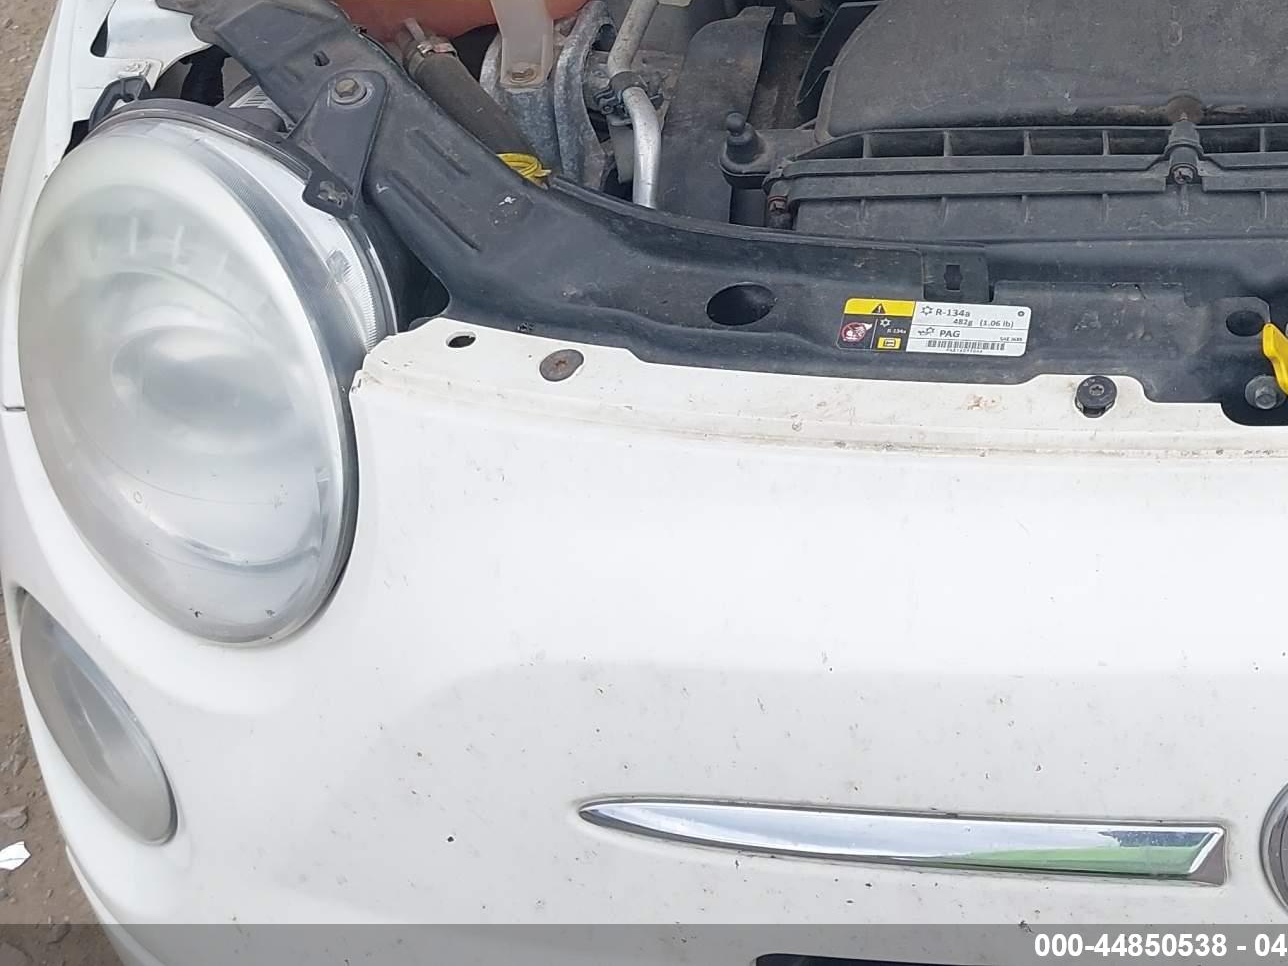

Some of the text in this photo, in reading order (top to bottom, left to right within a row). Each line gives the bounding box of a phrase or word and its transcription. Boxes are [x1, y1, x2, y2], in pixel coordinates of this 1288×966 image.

[935, 307, 971, 318] R-134a
[1002, 319, 1014, 328] lb)
[939, 329, 961, 338] PAG
